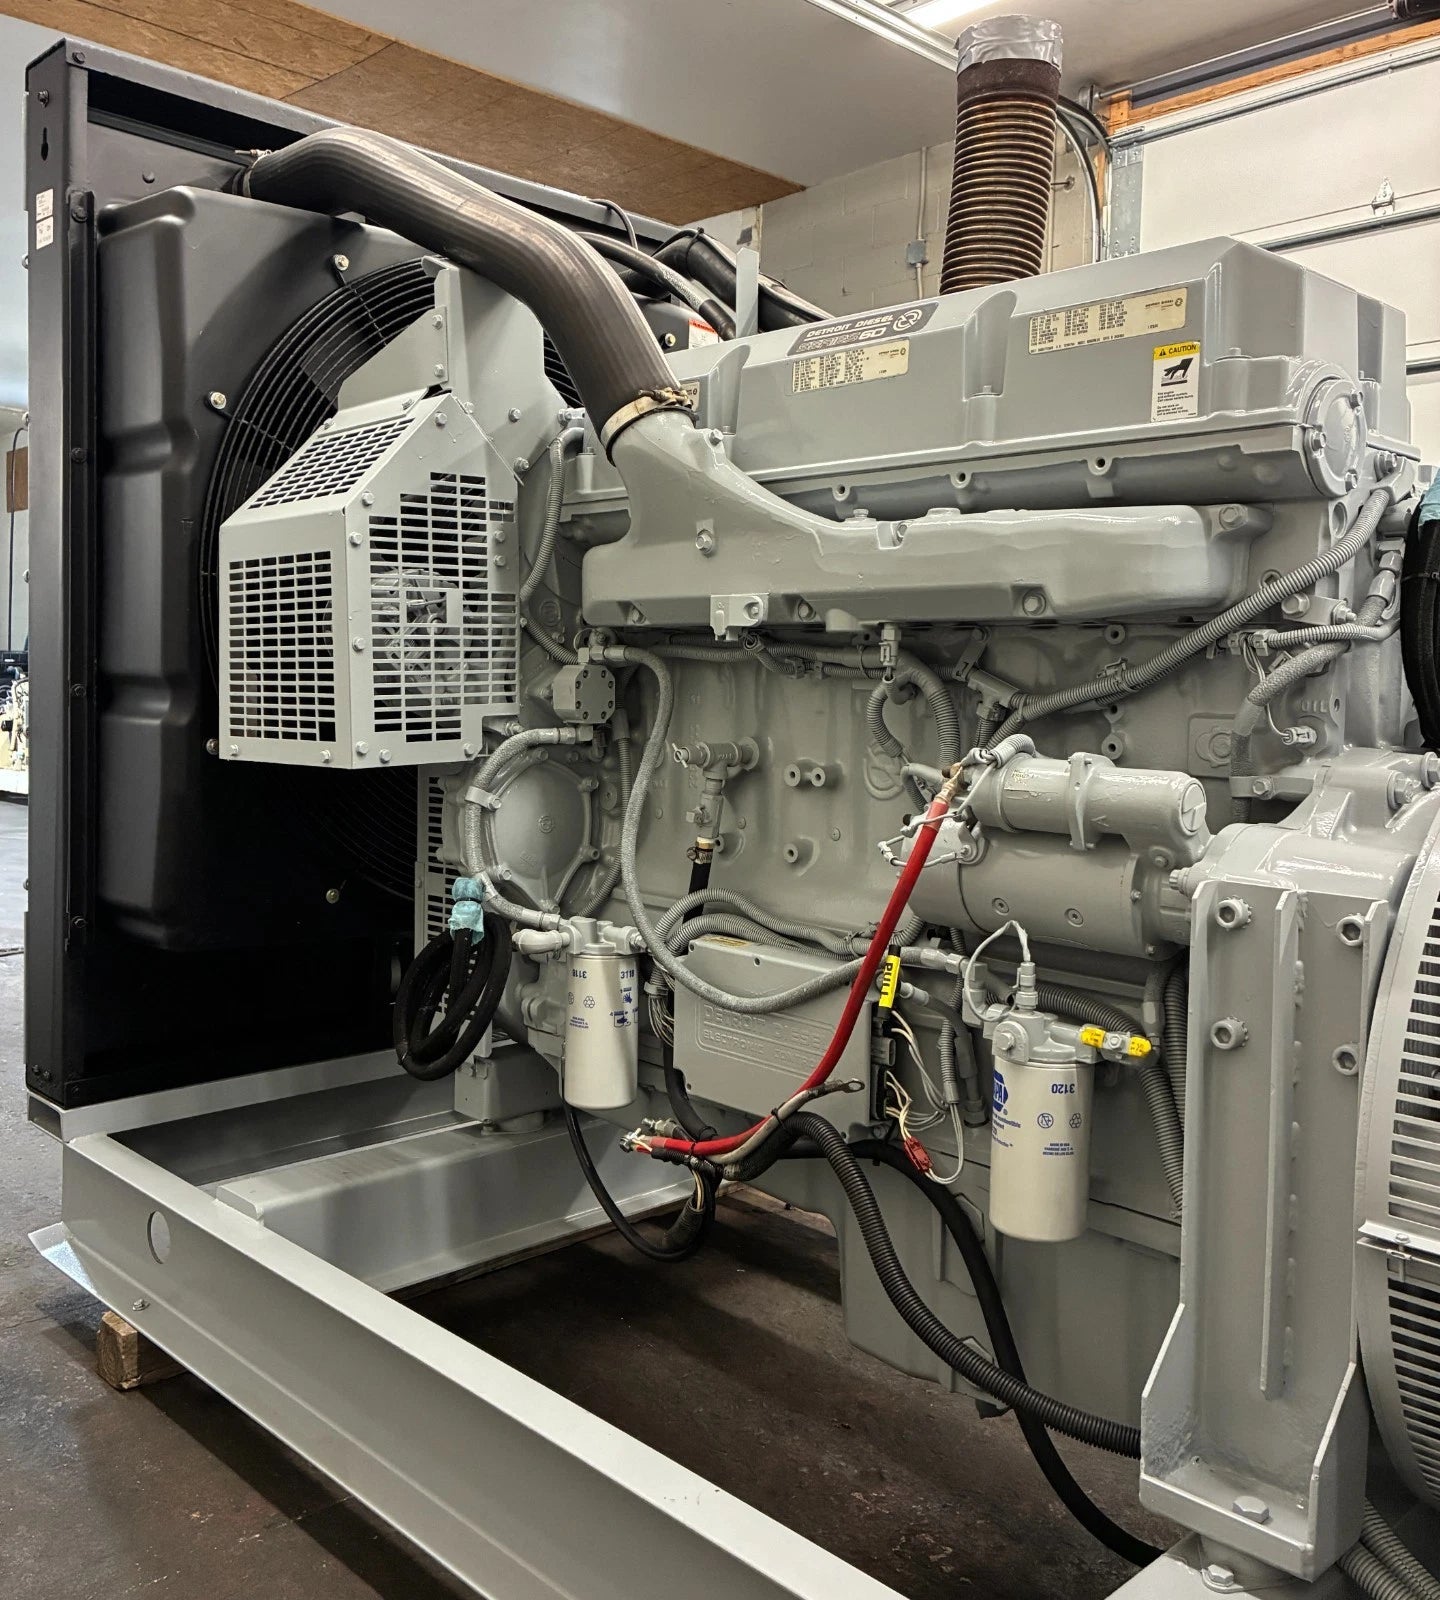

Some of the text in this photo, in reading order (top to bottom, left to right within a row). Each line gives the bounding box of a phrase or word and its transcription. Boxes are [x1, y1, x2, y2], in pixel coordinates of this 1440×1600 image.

[806, 314, 894, 338] DETROIT DIESEL
[859, 326, 887, 340] 60
[1168, 344, 1197, 354] CAUTION
[703, 1003, 766, 1036] DETROIT
[1052, 1083, 1075, 1094] 3120
